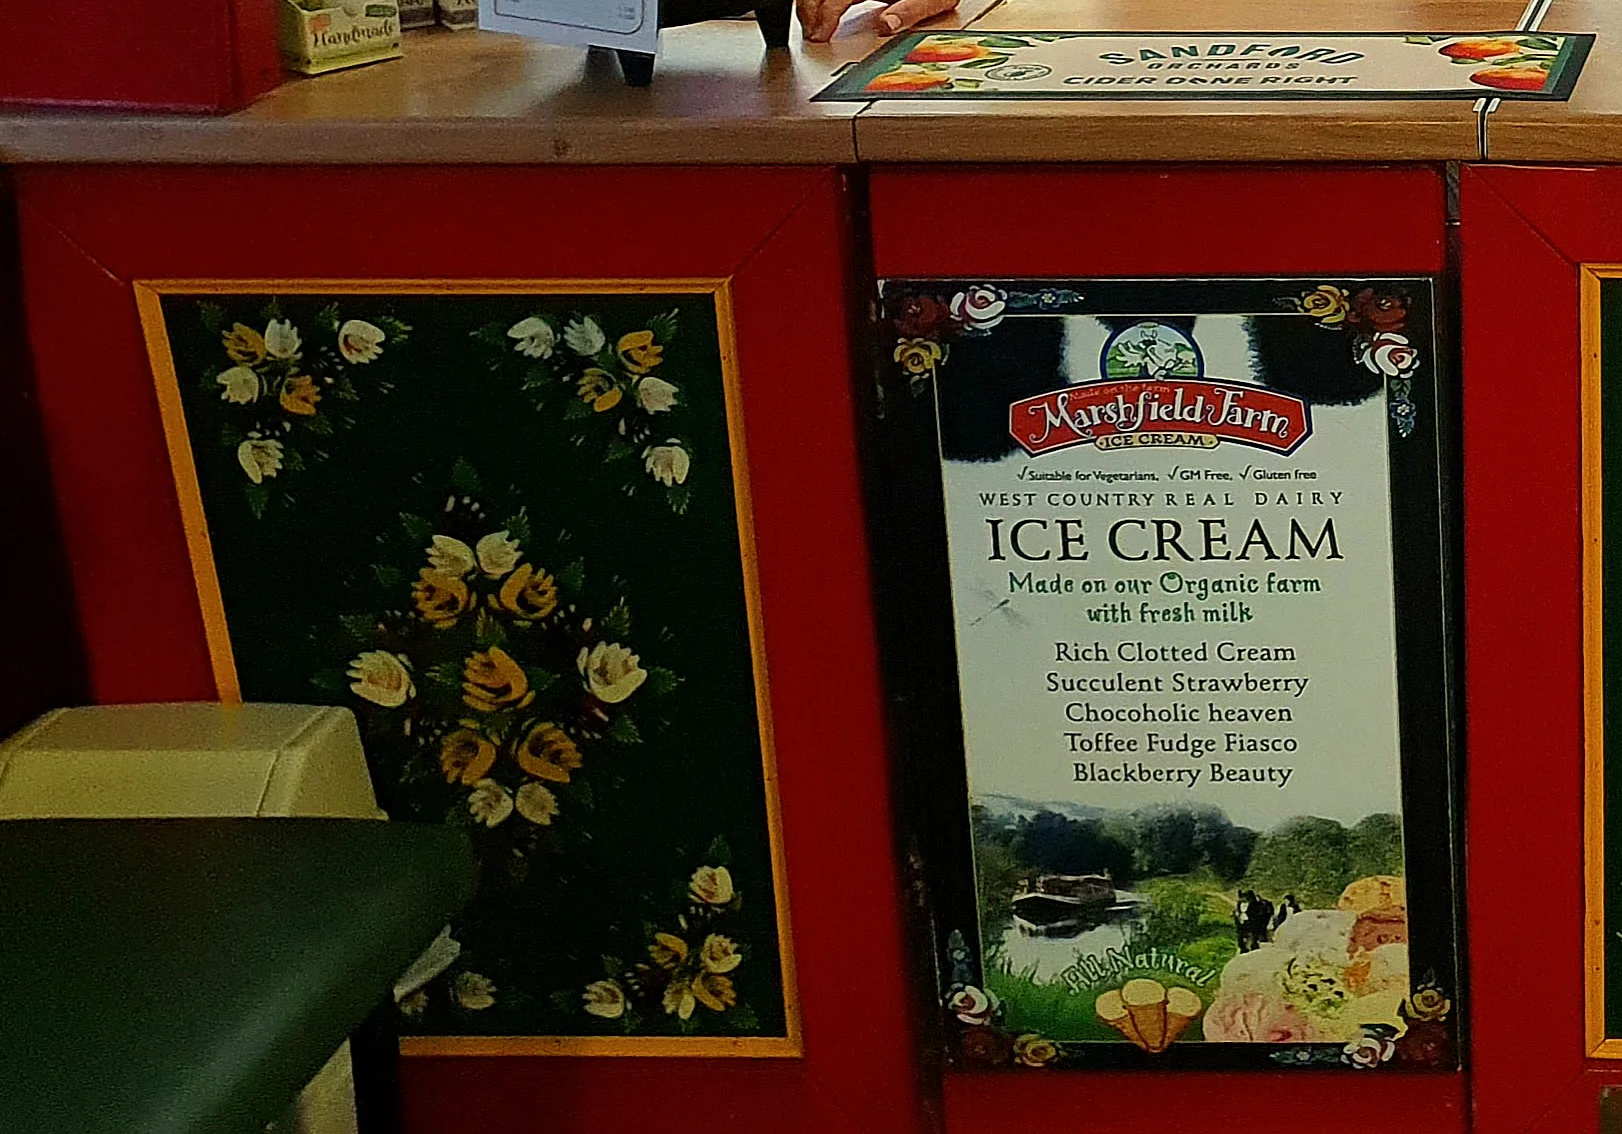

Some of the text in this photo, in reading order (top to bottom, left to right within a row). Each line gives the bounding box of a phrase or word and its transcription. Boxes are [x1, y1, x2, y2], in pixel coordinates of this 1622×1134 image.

[313, 20, 394, 47] Handmade
[1099, 43, 1365, 66] SANDFORD
[1147, 61, 1300, 71] ORCHARDS
[1061, 76, 1359, 86] CIDER DONE RIGHT
[1028, 388, 1289, 443] Marshfield Farm
[1104, 433, 1205, 448] ICE CREAM
[1028, 469, 1072, 482] Suitable
[1075, 469, 1091, 481] for
[1180, 469, 1202, 481] GM
[1253, 469, 1317, 481] Gluten free
[979, 491, 1344, 506] WEST COUNTRY REAL DAIRY
[986, 518, 1344, 562] ICE CREAM
[1008, 571, 1321, 600] Made on our Organic farm
[1087, 602, 1253, 623] with fresh milk
[1055, 642, 1296, 662] Rich Clotted Cream
[1046, 673, 1309, 697] Succulent Strawberry
[1065, 702, 1294, 723] Chocoholic heaven
[1064, 733, 1298, 759] Toffee Fudge Fiasco
[1072, 763, 1294, 788] Blackberry Beauty
[1061, 944, 1217, 996] All Natural
